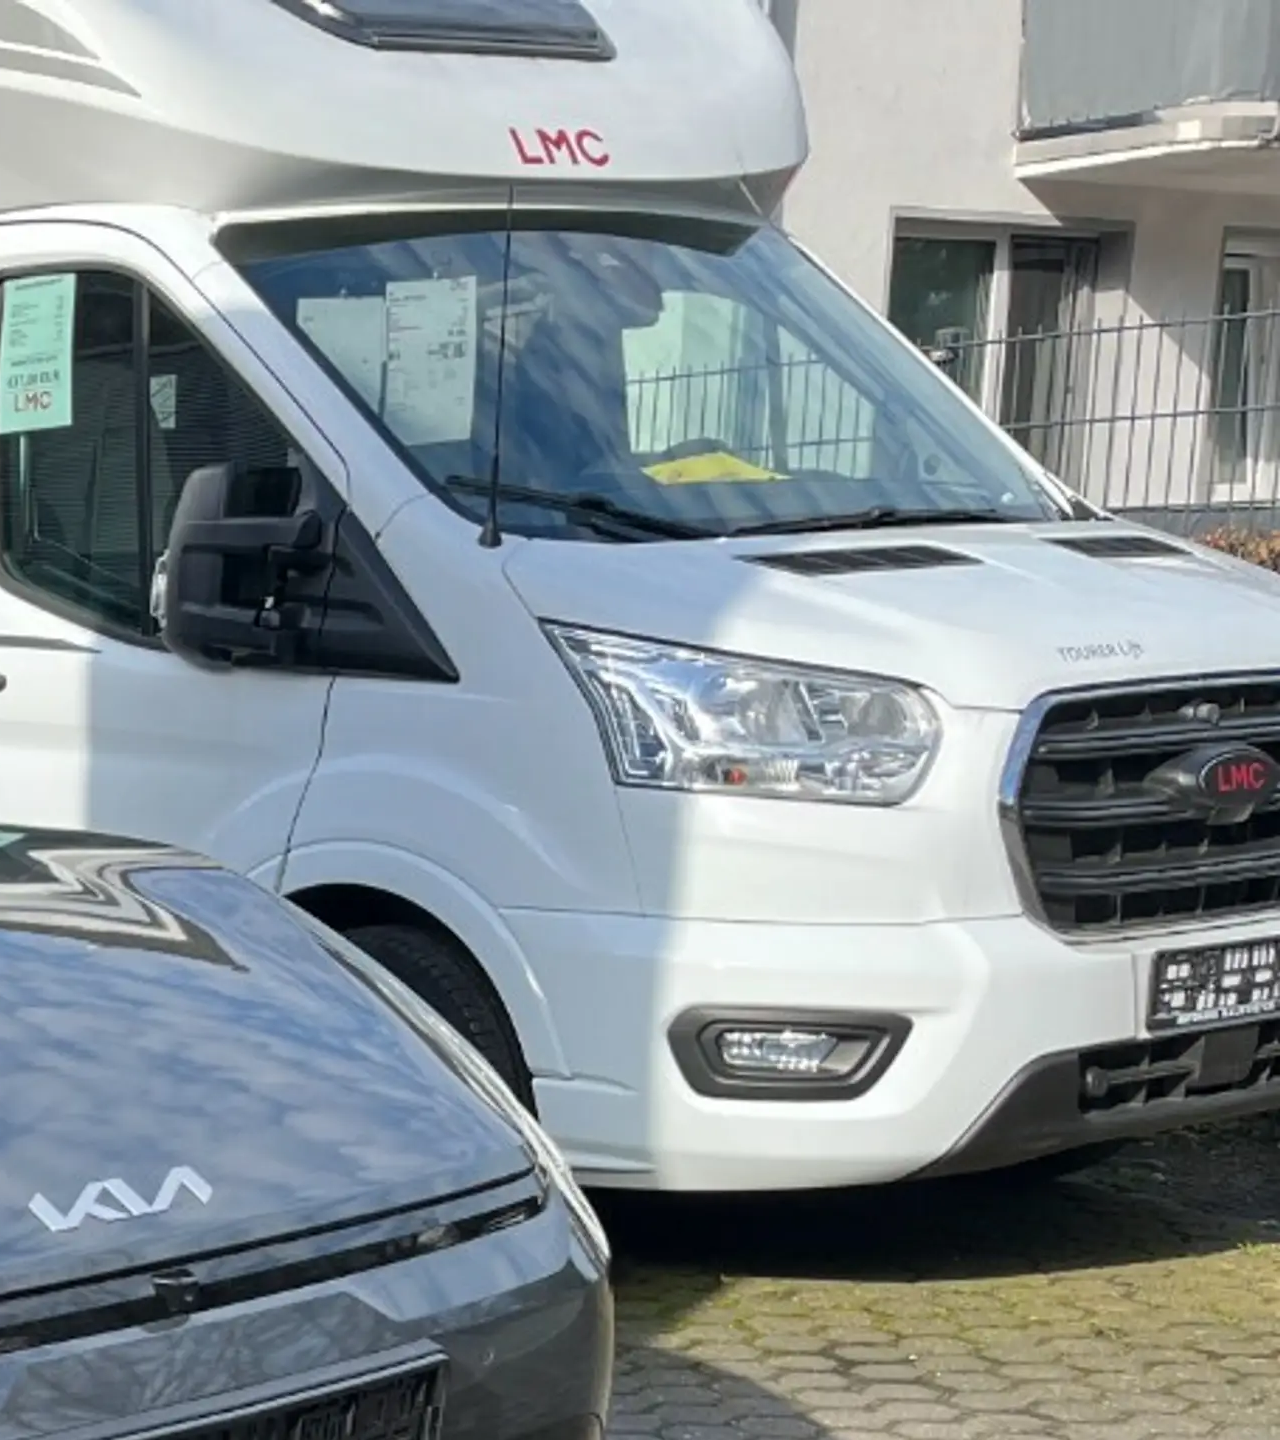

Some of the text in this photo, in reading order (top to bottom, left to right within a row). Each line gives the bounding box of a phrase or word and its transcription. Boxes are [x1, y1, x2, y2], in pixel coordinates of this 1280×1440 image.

[507, 126, 610, 167] LMC
[14, 391, 52, 413] LMC
[1217, 762, 1266, 792] LMC
[28, 1165, 213, 1232] KIA
